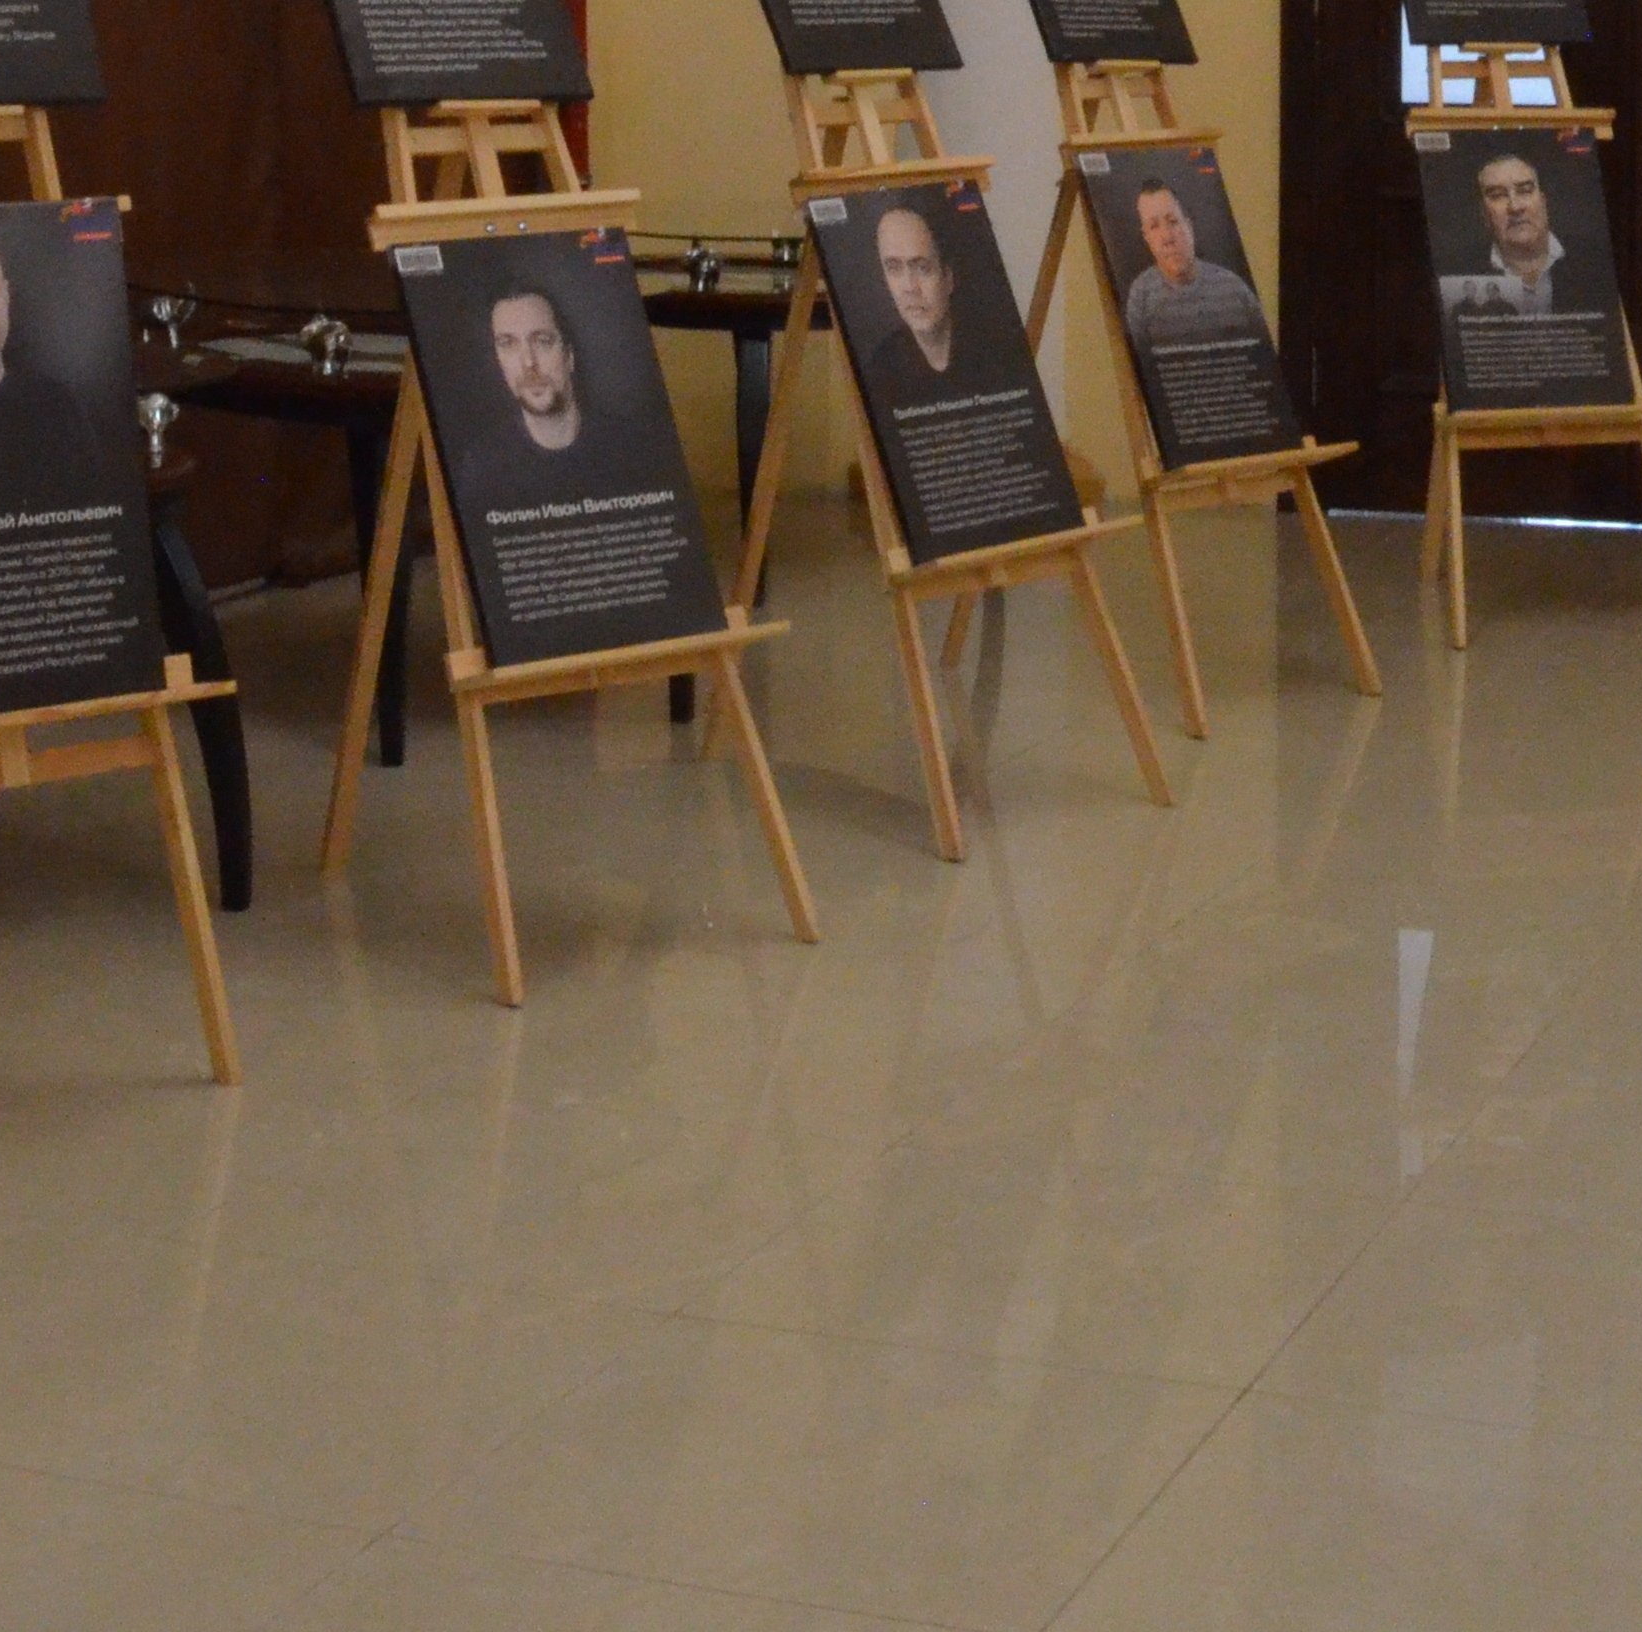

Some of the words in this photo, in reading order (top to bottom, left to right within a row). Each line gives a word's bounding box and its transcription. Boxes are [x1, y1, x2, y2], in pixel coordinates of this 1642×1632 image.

[485, 508, 541, 523] Филин
[541, 504, 582, 516] Иван
[582, 493, 675, 512] Викторович
